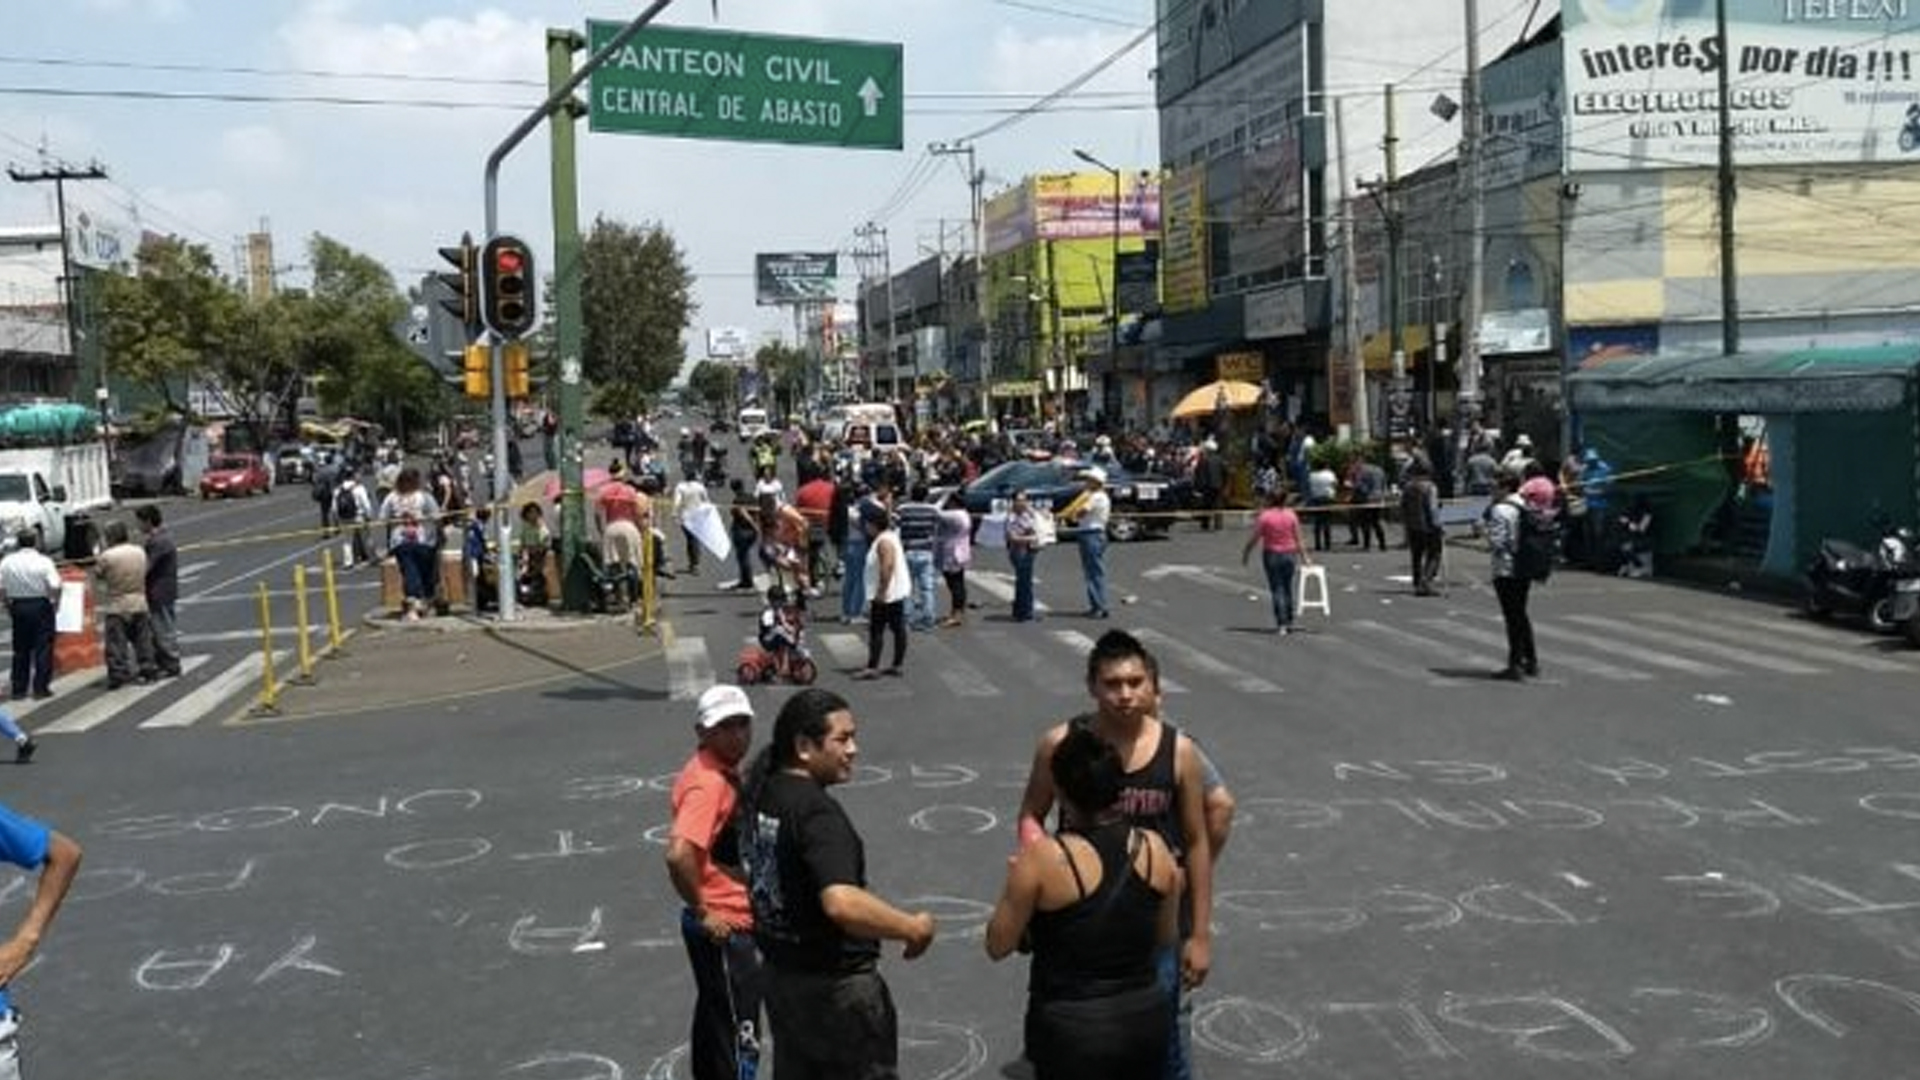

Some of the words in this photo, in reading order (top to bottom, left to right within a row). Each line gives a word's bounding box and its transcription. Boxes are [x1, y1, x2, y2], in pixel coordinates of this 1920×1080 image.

[765, 55, 841, 86] CIVIL
[1738, 45, 1797, 74] por
[602, 87, 703, 119] CENTRAL
[718, 95, 746, 121] DE
[760, 100, 841, 128] ABASTO
[1574, 85, 1792, 116] ELECTRONCOS
